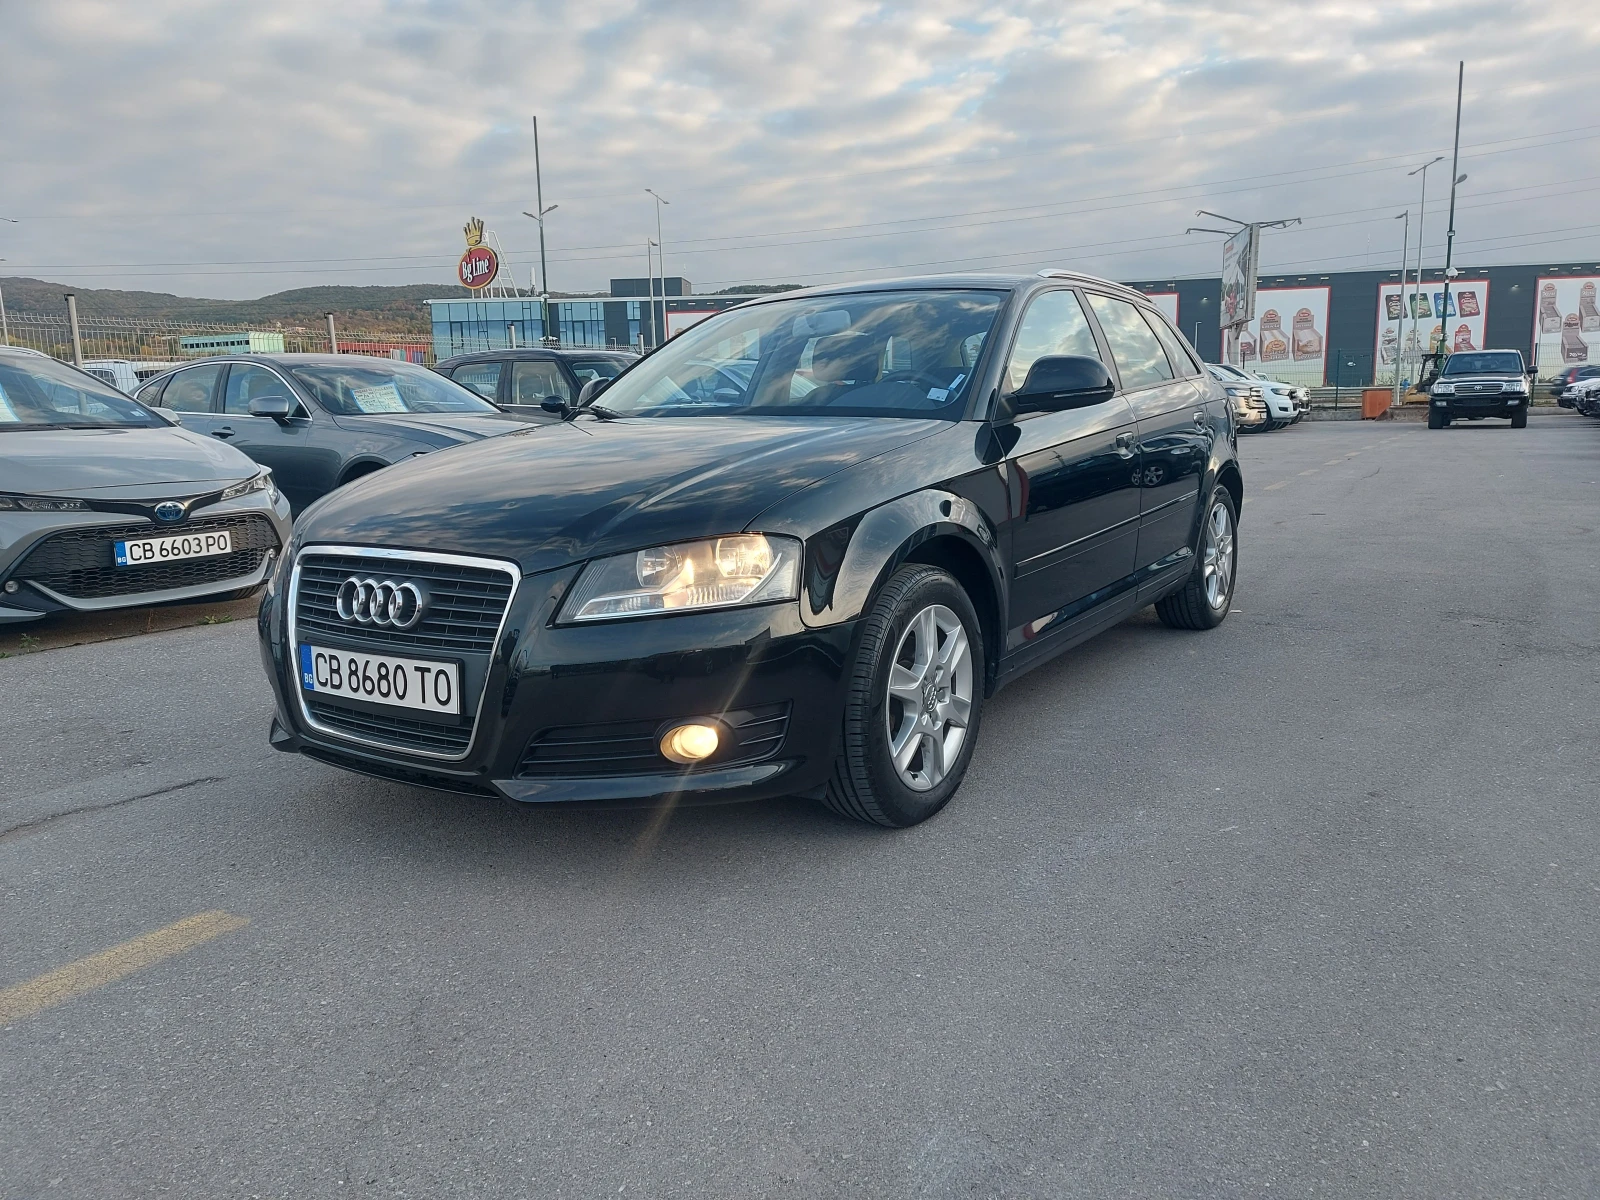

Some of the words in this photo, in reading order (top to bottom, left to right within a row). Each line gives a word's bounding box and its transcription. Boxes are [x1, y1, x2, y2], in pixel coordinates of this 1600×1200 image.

[462, 261, 473, 283] Bg
[472, 256, 489, 277] Line
[129, 542, 155, 561] CB
[159, 537, 203, 558] 6603
[205, 534, 228, 553] PO
[304, 672, 313, 684] BG
[314, 652, 343, 690] CB
[347, 657, 408, 701] 8680
[413, 665, 452, 706] TO
